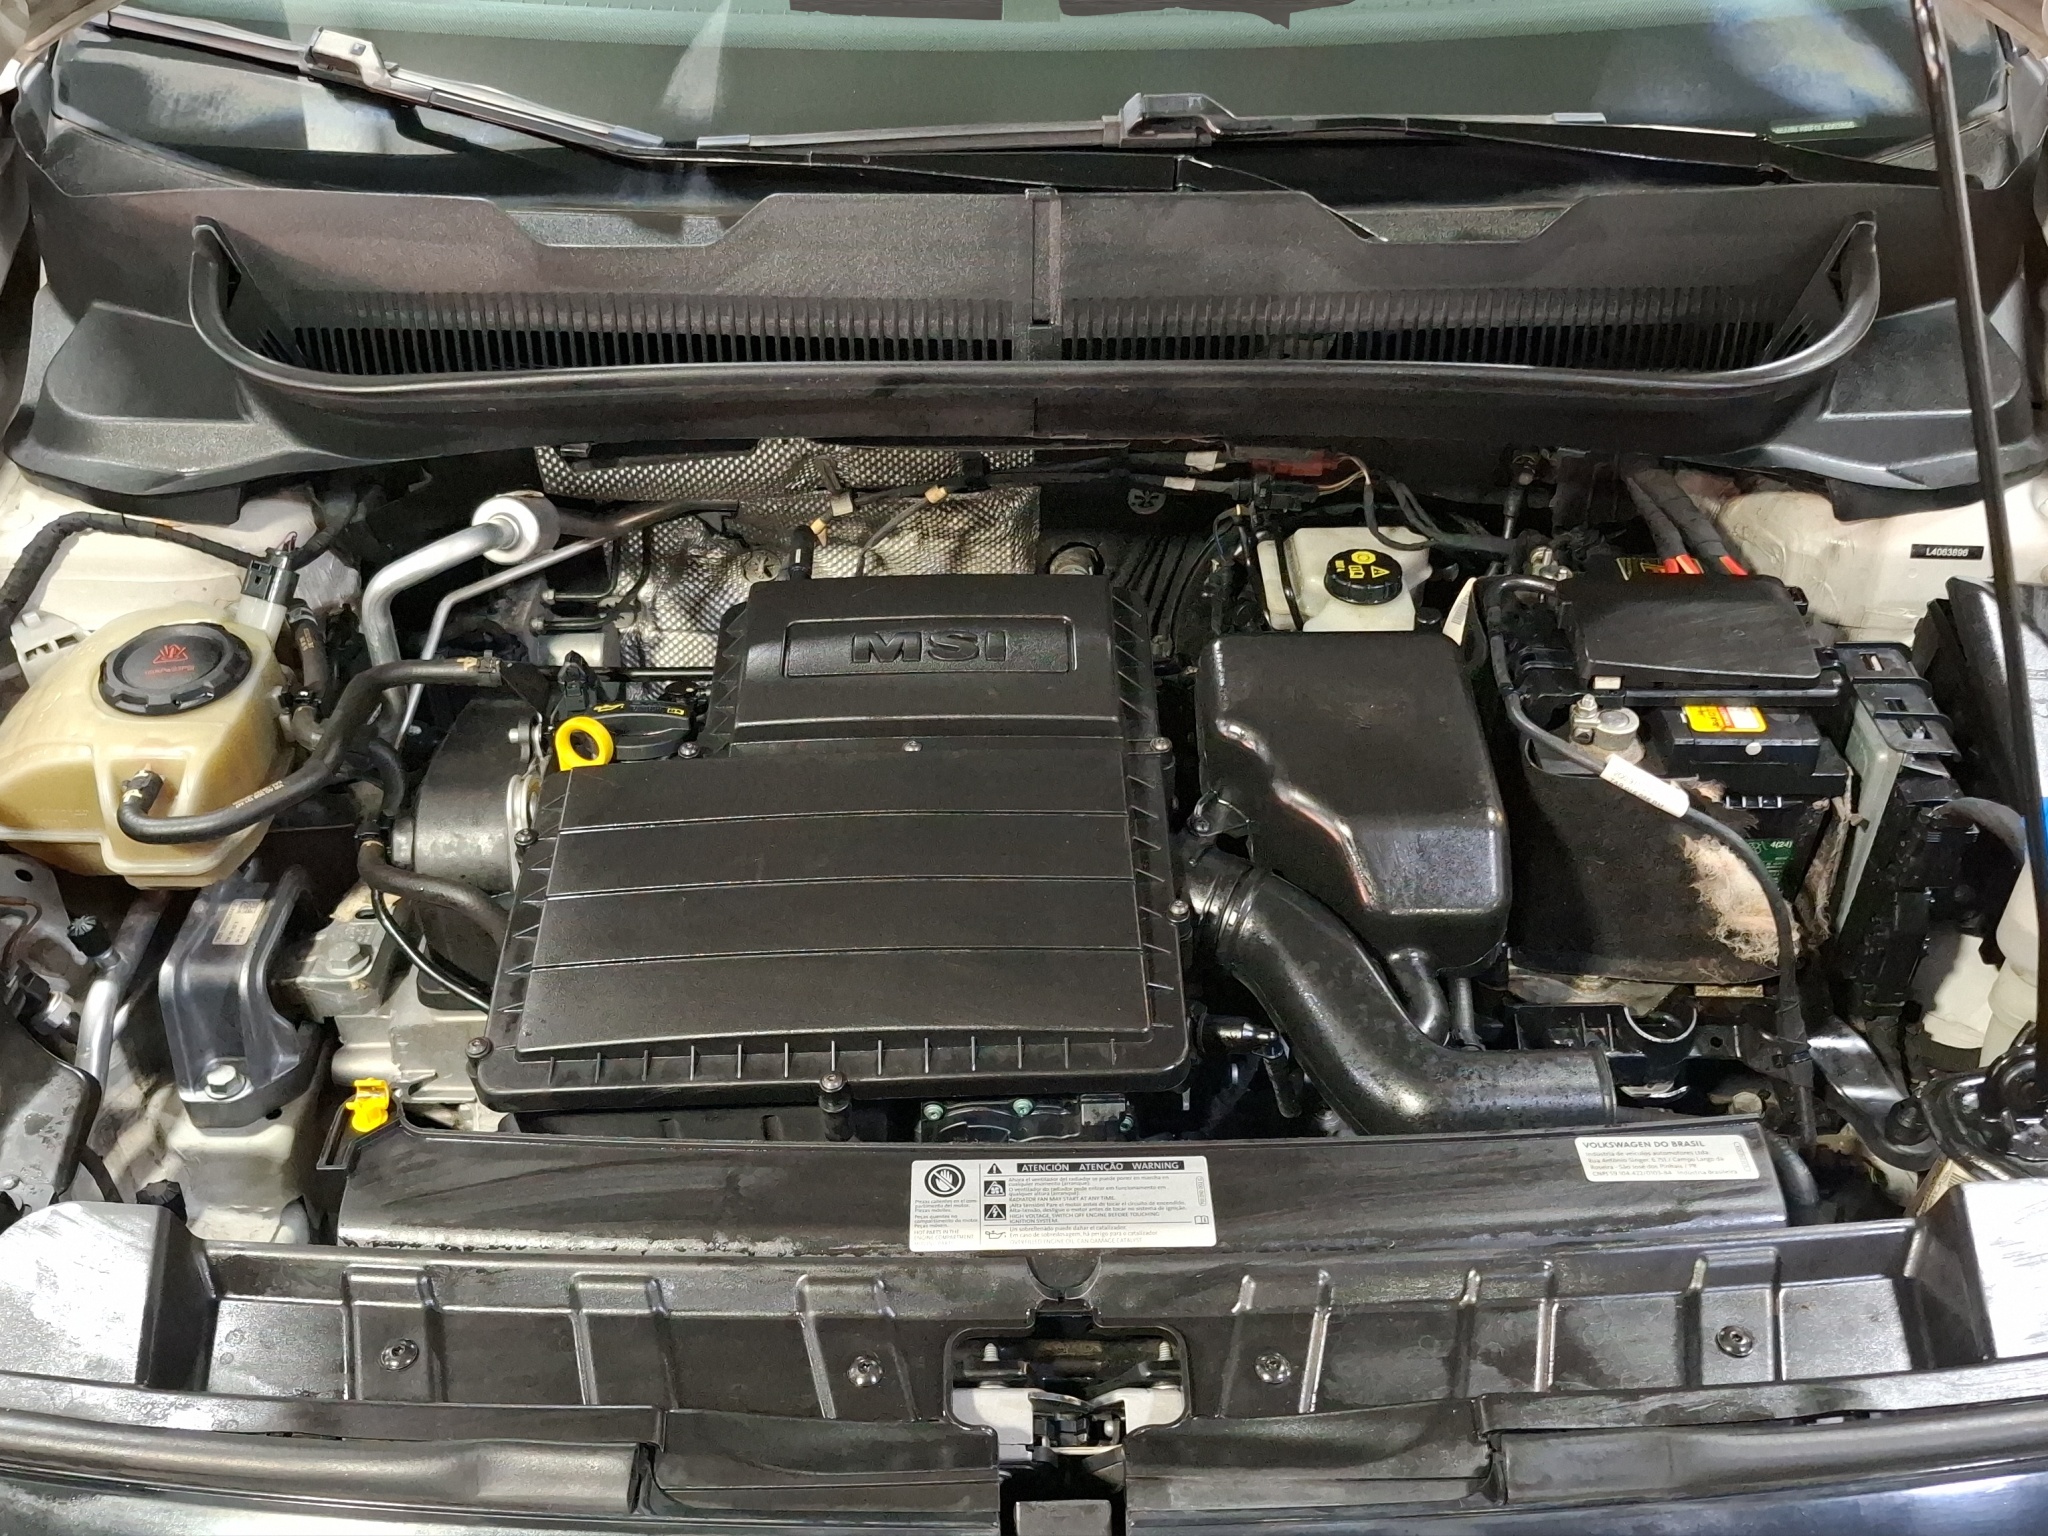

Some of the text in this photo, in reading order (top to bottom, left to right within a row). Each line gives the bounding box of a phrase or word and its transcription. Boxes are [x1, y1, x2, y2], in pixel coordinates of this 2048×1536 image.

[851, 629, 1006, 663] MSI
[1671, 1140, 1706, 1148] BRASIL
[1021, 1161, 1179, 1172] ATENCIÓN ATENÇÃO WARNING
